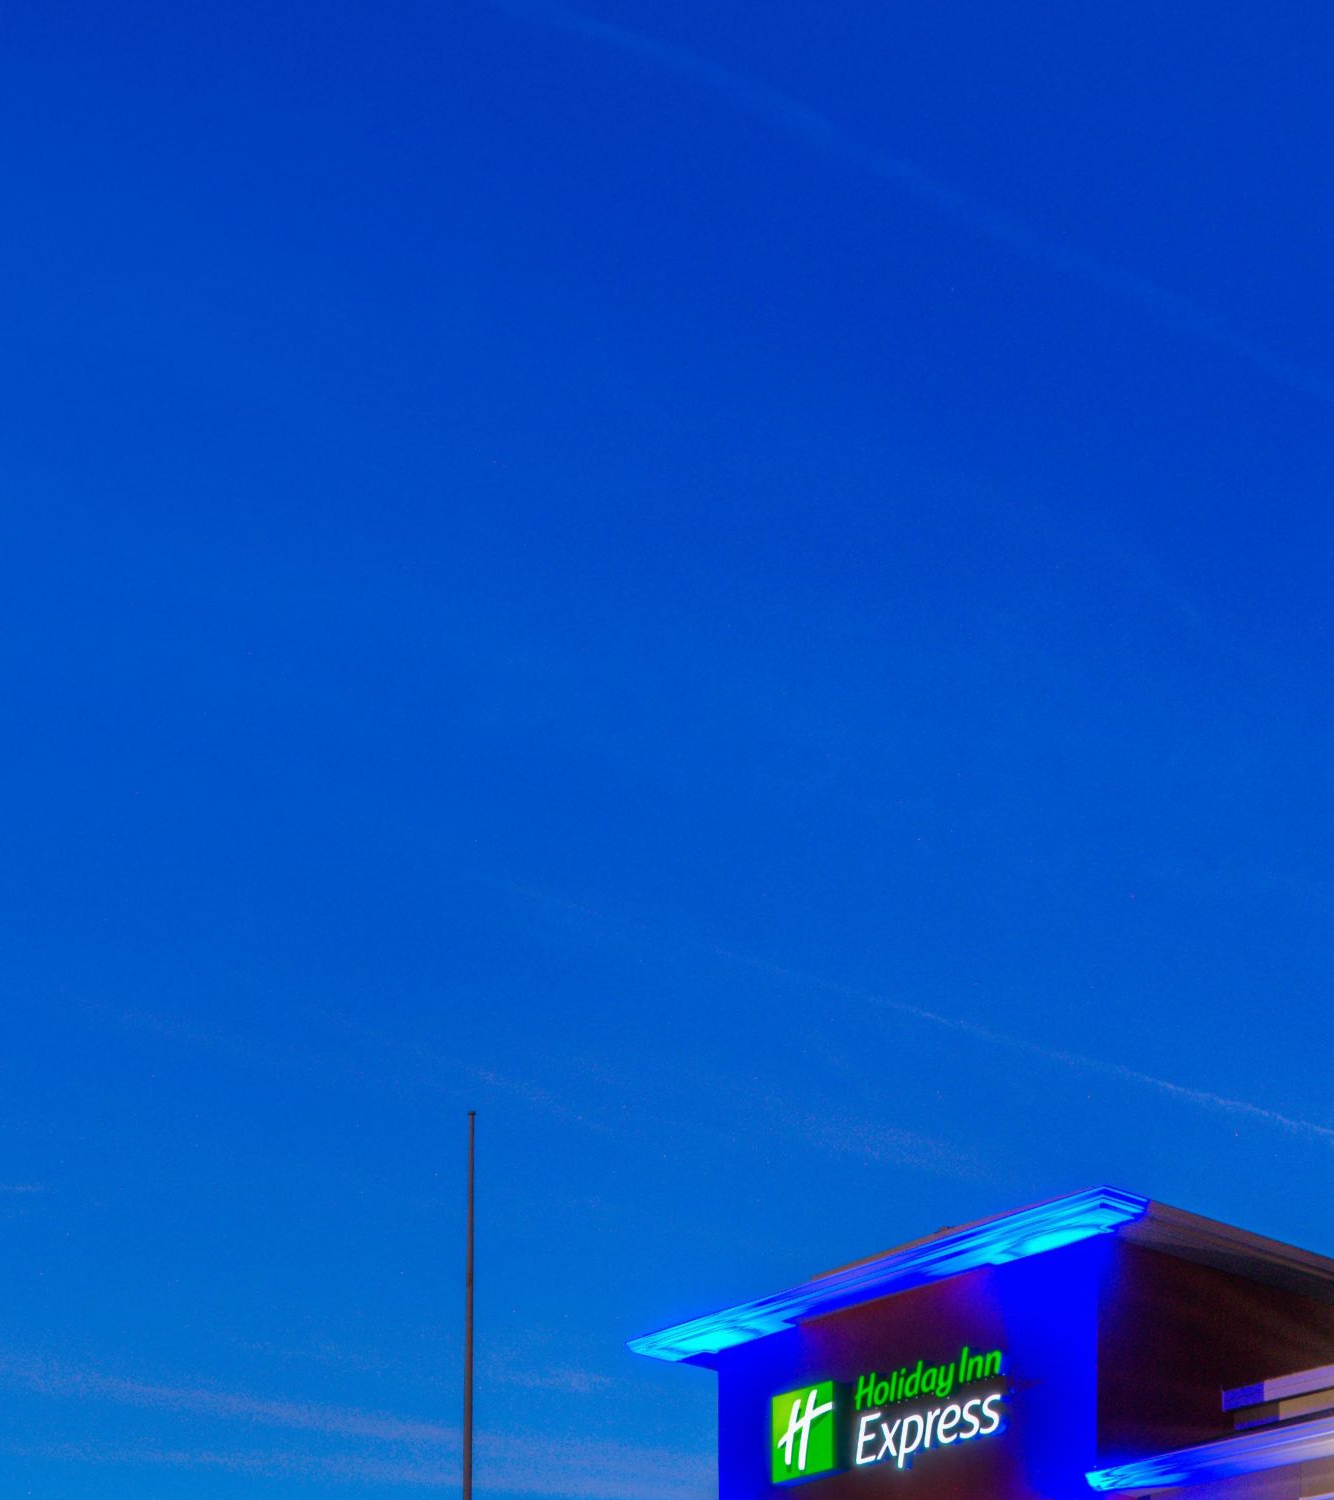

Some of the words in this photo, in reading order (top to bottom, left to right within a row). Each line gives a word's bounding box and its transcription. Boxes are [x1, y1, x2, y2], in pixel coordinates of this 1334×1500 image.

[855, 1360, 954, 1411] Holiday
[959, 1346, 1002, 1384] Inn
[855, 1394, 1001, 1468] Express
